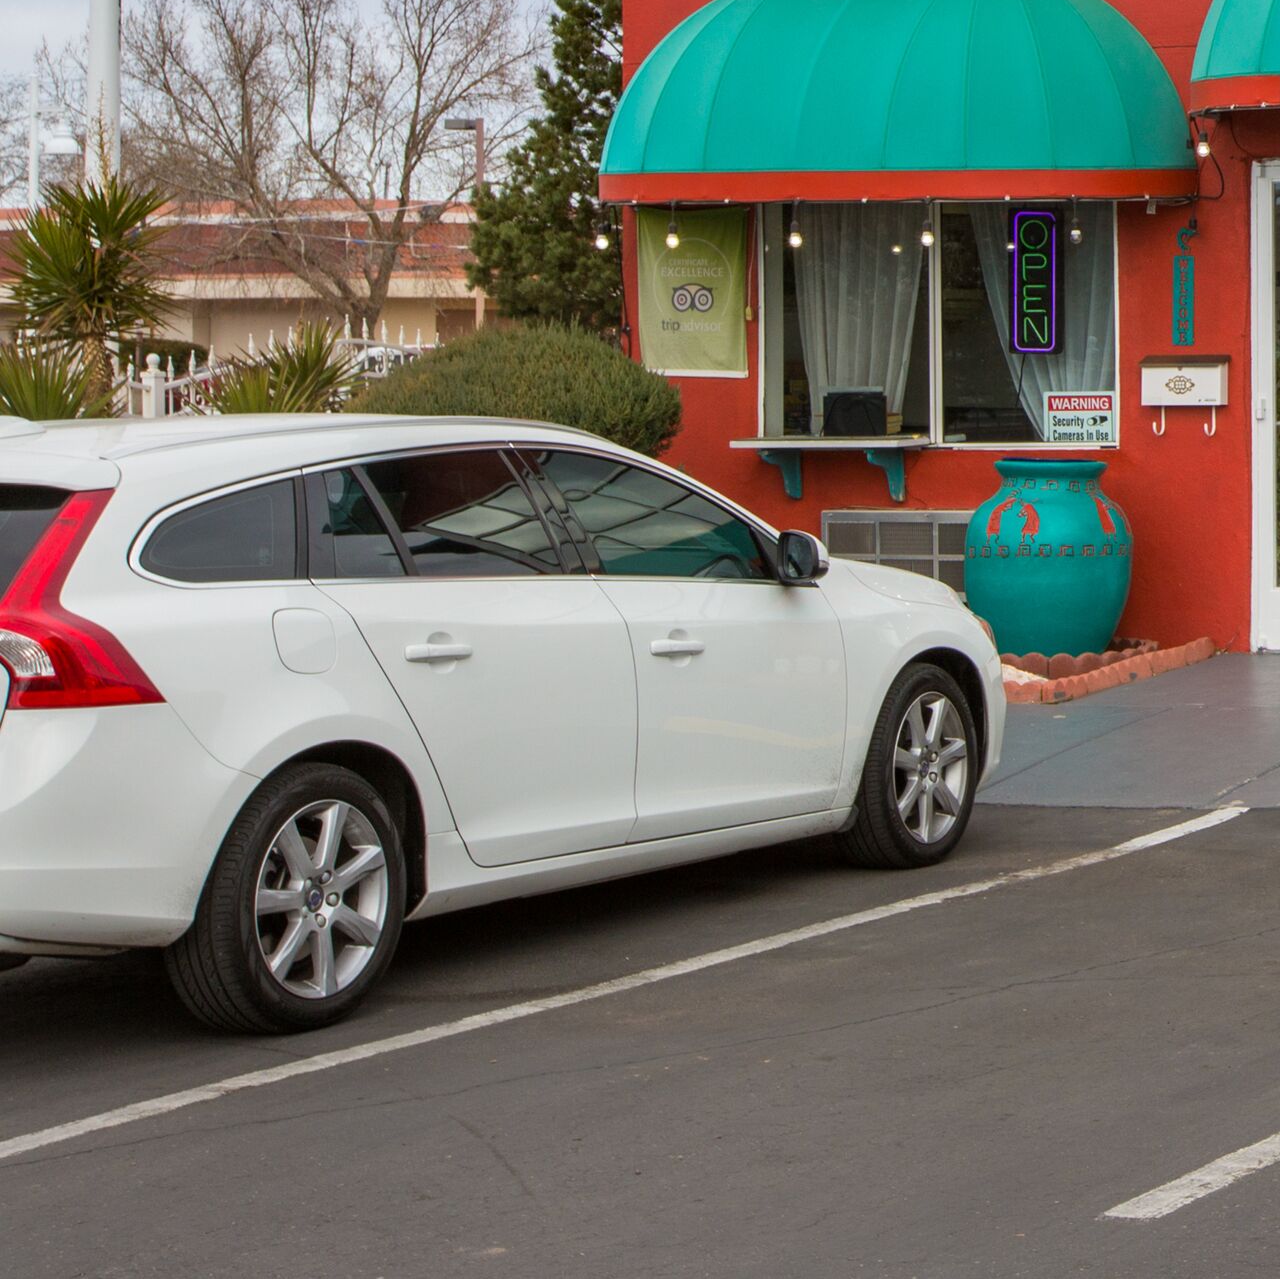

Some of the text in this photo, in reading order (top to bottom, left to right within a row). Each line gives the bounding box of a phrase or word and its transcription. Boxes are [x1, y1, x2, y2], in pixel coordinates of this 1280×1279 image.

[661, 267, 724, 278] EXCELLENCE
[1020, 220, 1048, 344] OPEN
[1178, 259, 1189, 343] WELCOME
[661, 319, 720, 333] tripadvisor
[1051, 397, 1109, 410] WARNING
[1052, 415, 1085, 429] Security
[1052, 429, 1109, 441] Cameras In Use
